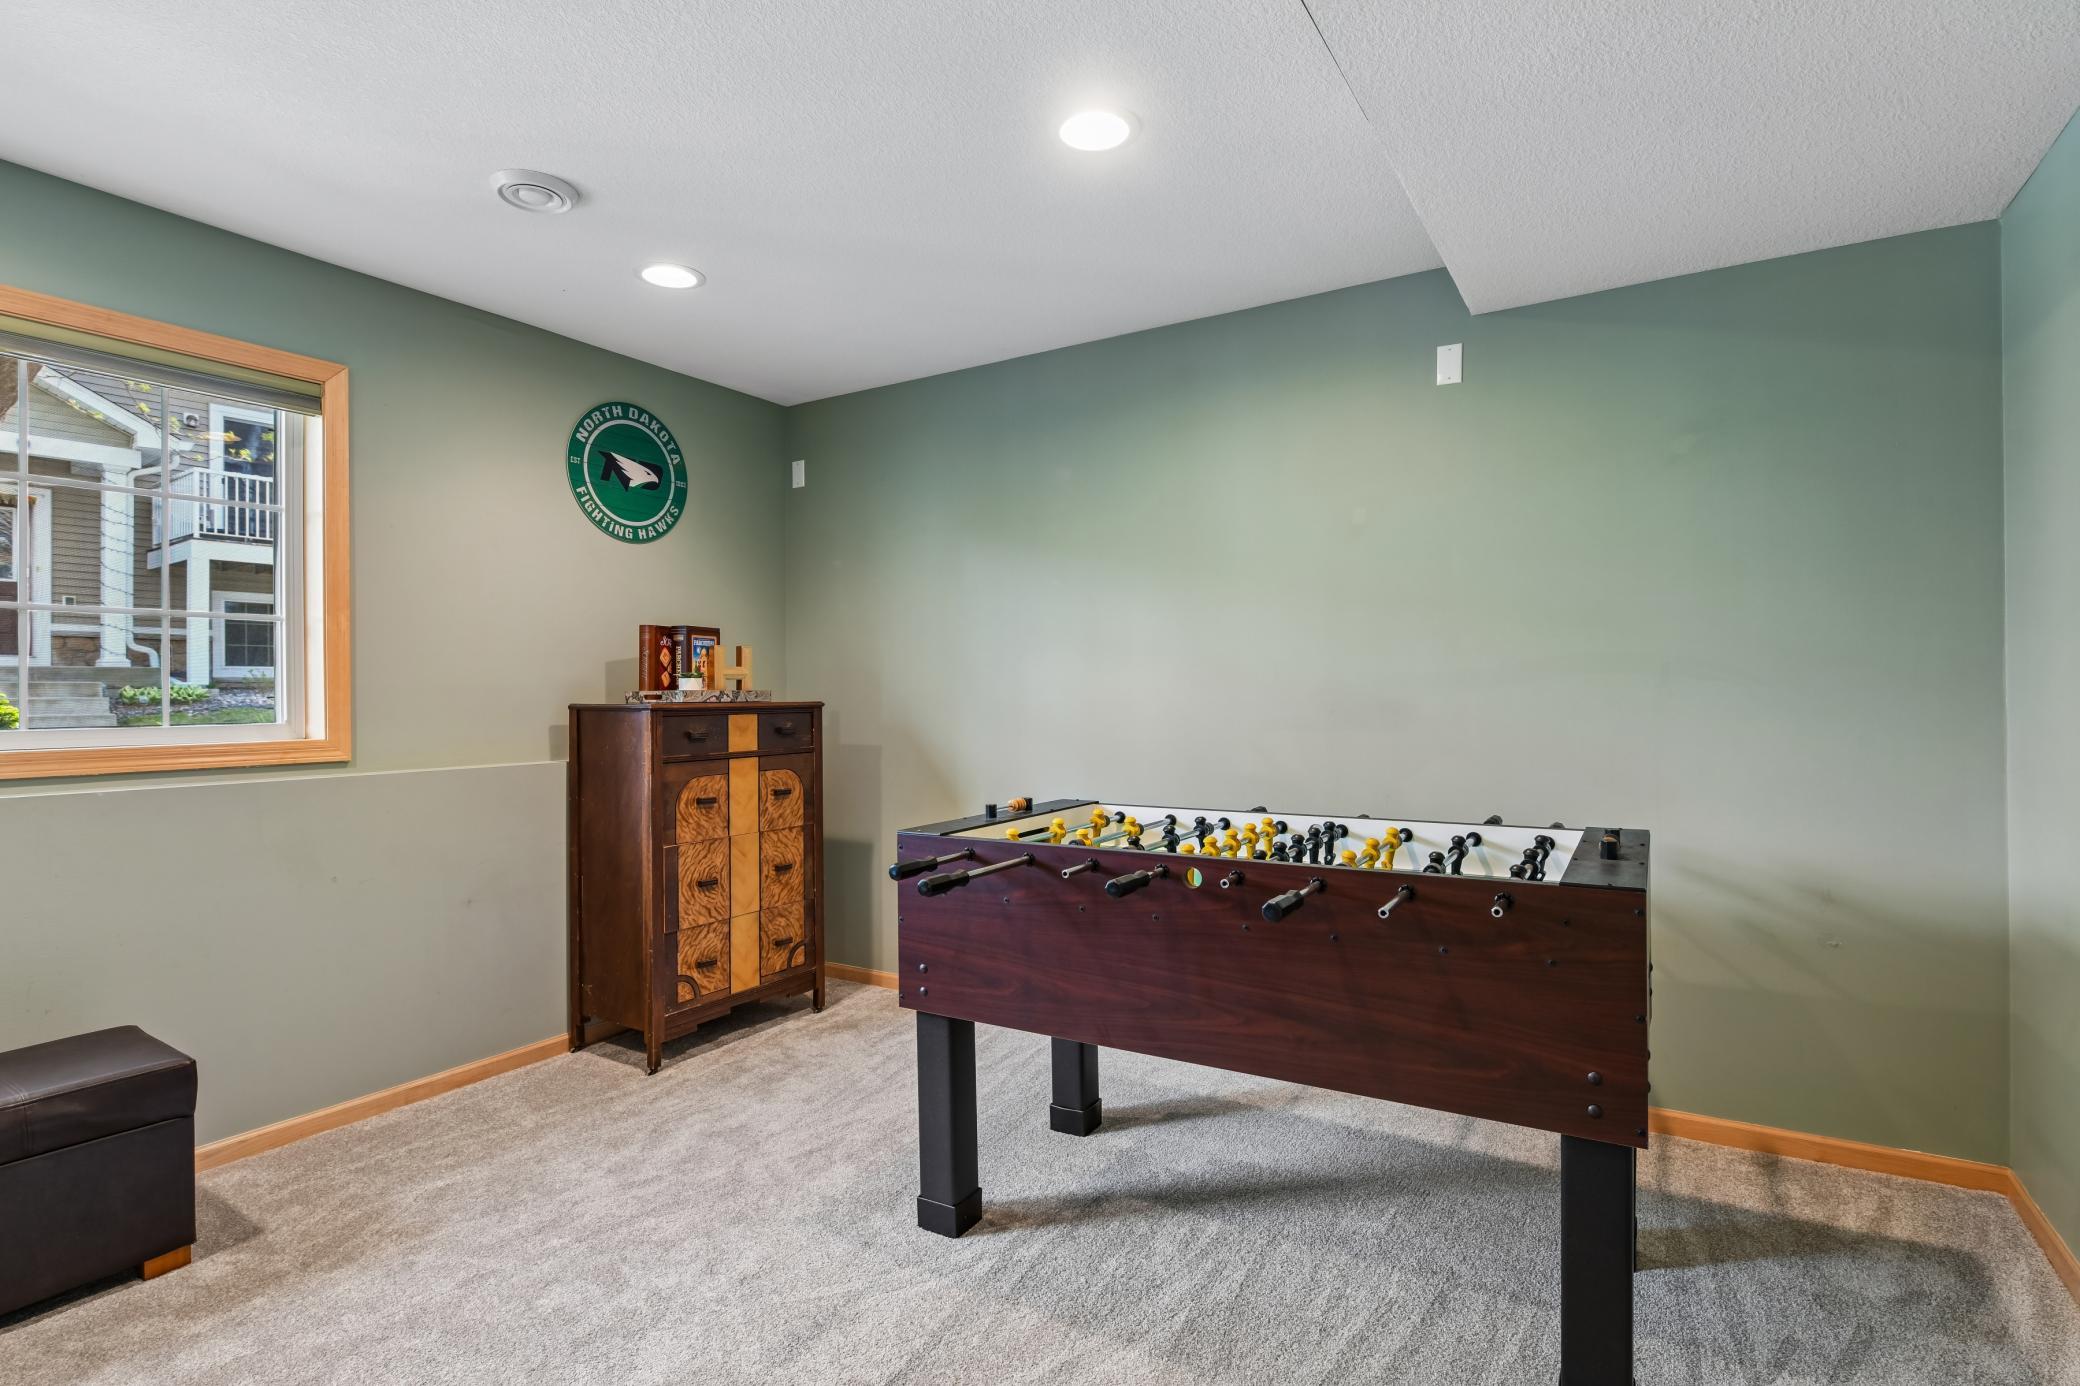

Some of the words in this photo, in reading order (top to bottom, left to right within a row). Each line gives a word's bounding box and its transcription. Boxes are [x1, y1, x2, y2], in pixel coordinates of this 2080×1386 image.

[576, 405, 623, 443] NORTH
[628, 407, 682, 465] DAKOTA
[575, 486, 634, 539] FIGHTING
[638, 505, 679, 539] HAWKS
